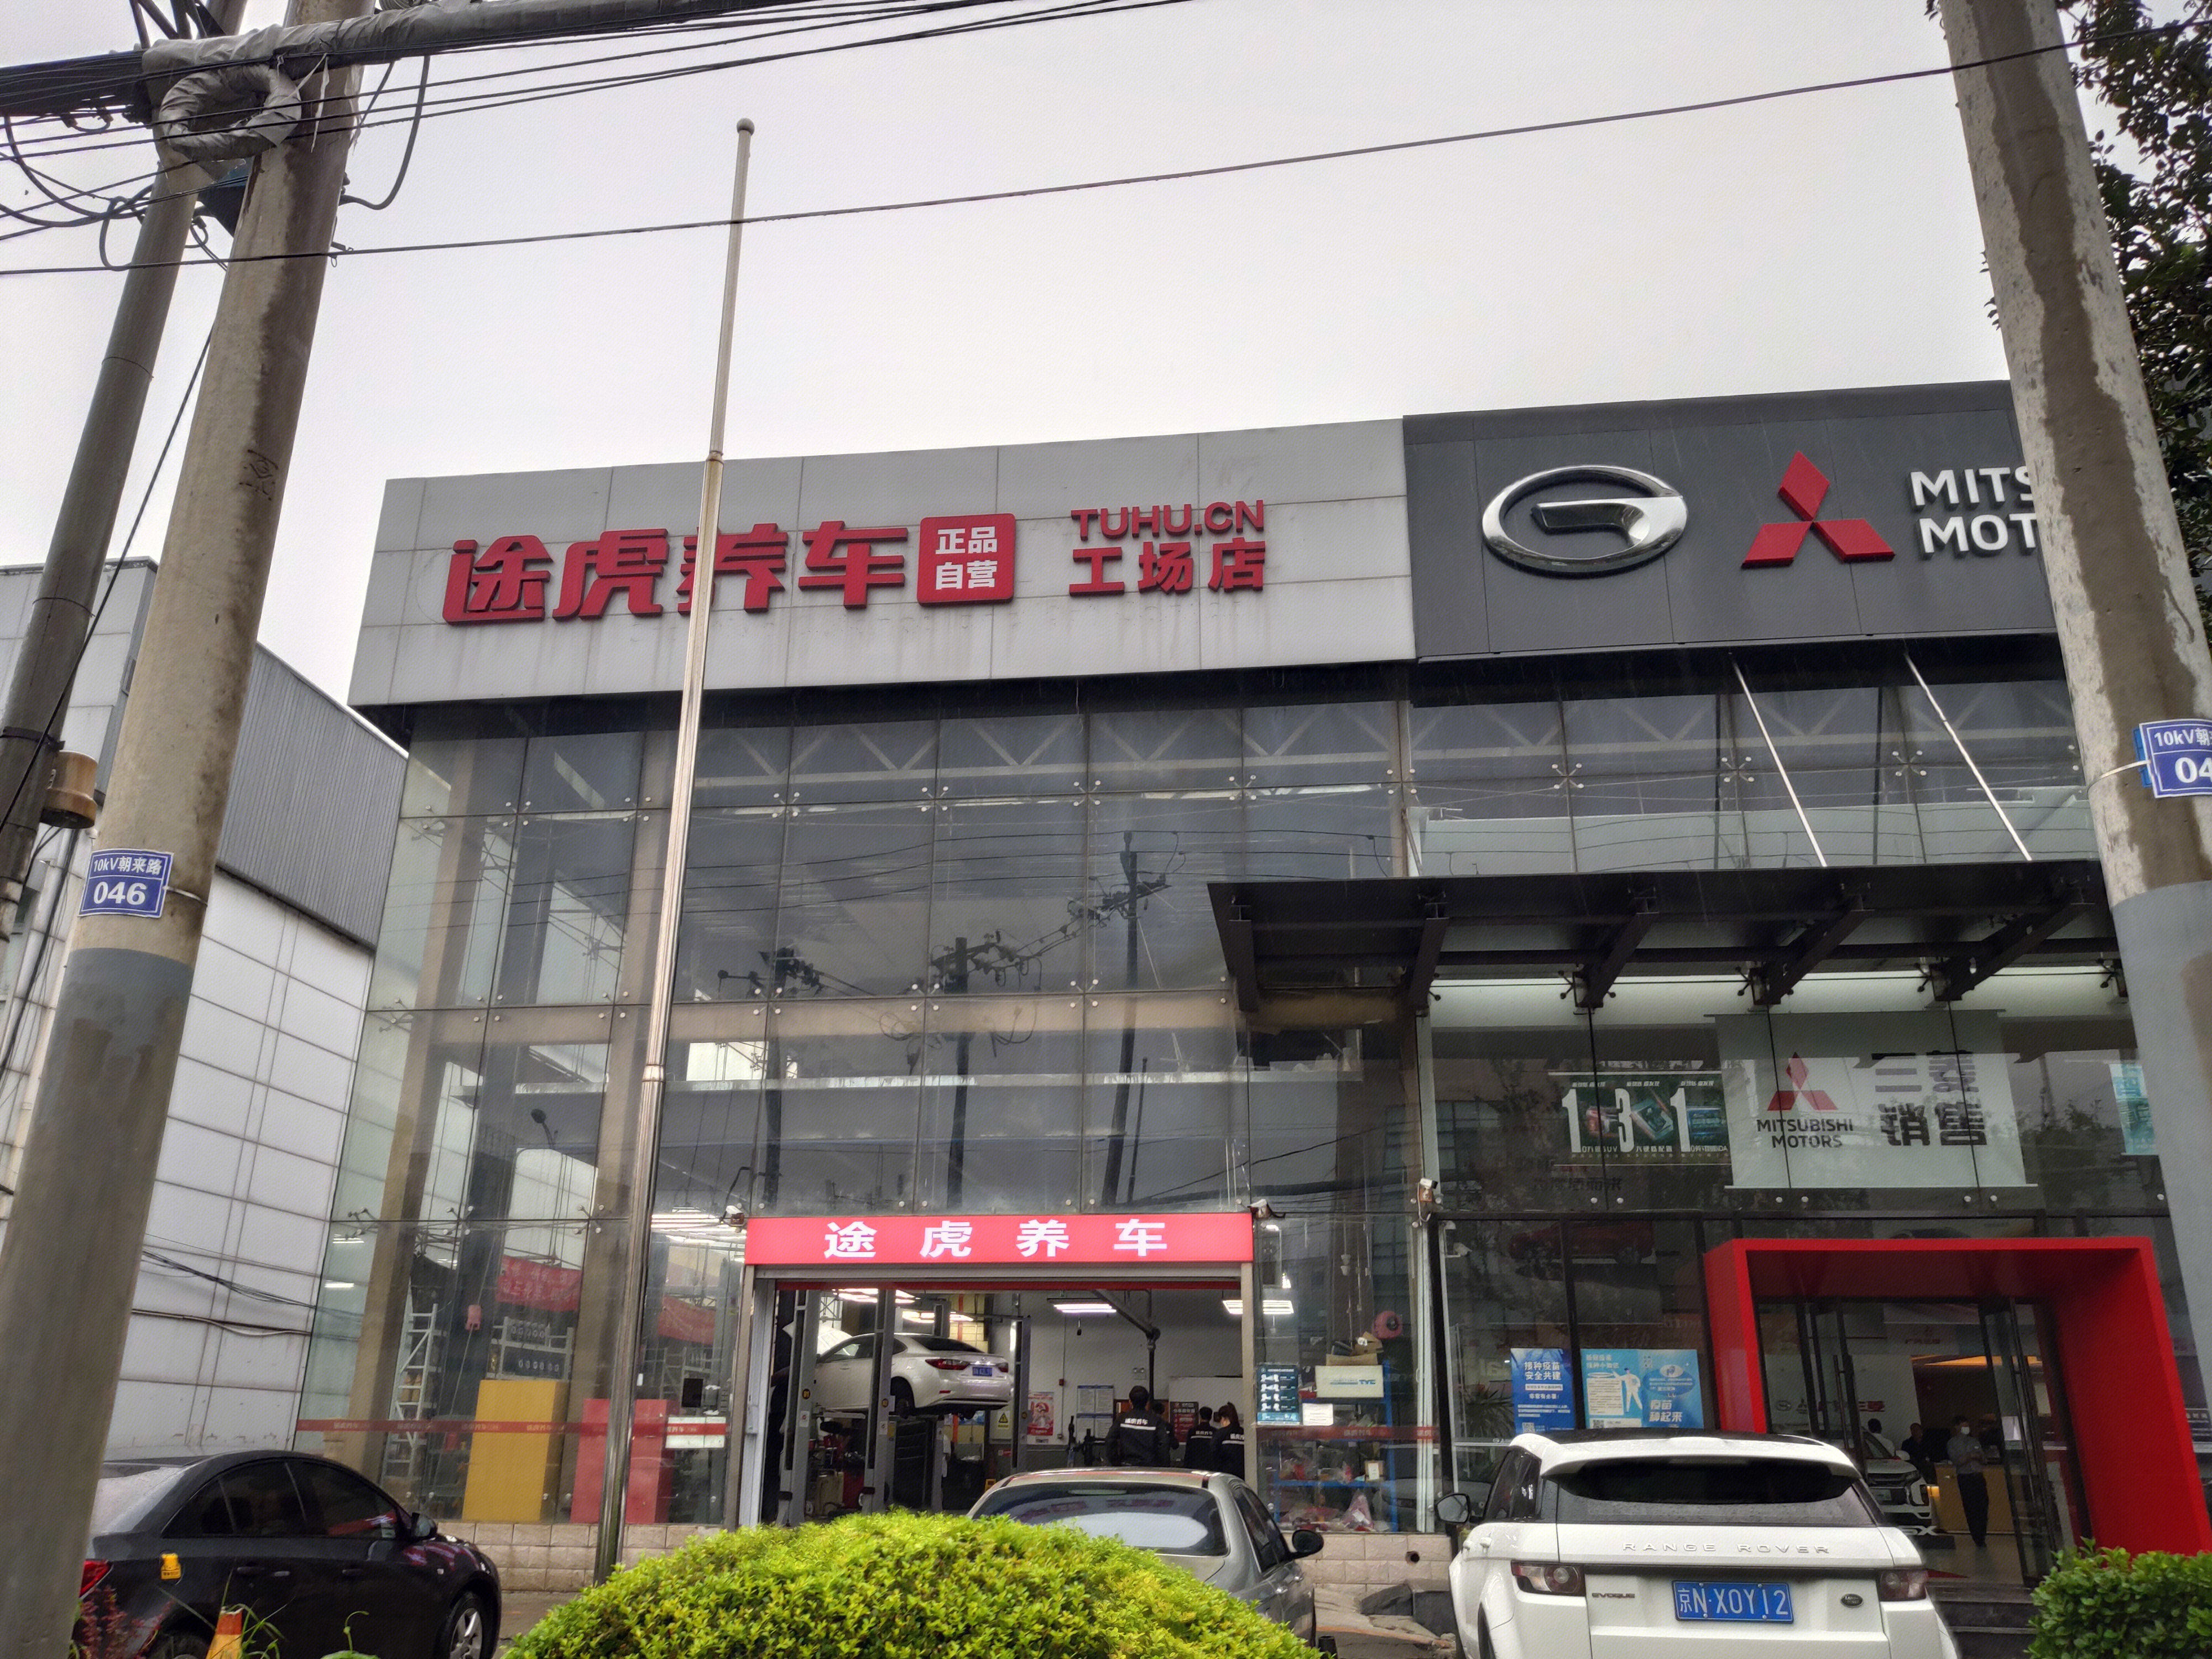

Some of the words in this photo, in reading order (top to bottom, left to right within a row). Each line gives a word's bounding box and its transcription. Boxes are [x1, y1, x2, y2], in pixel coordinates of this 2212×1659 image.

[1071, 499, 1265, 541] TUHU.CN
[935, 526, 998, 555] 正品
[442, 521, 909, 625] 途虎养车
[935, 561, 998, 590] 自营
[1069, 536, 1266, 597] 工场店
[2153, 727, 2212, 747] 10kV朝
[93, 855, 163, 875] 10kV朝来路
[93, 881, 147, 906] 046
[1756, 1118, 1853, 1133] MITSUBISHI
[1877, 1102, 1987, 1146] 销售
[1771, 1134, 1843, 1149] MOTORS
[823, 1218, 1167, 1259] 途虎养车
[1524, 1361, 1561, 1371] 接种疫苗
[1525, 1371, 1562, 1381] 安全共建
[1650, 1399, 1673, 1410] 疫苗
[1649, 1411, 1683, 1422] 种起来
[1621, 1541, 1716, 1552] RANGE
[1736, 1543, 1830, 1554] ROVER
